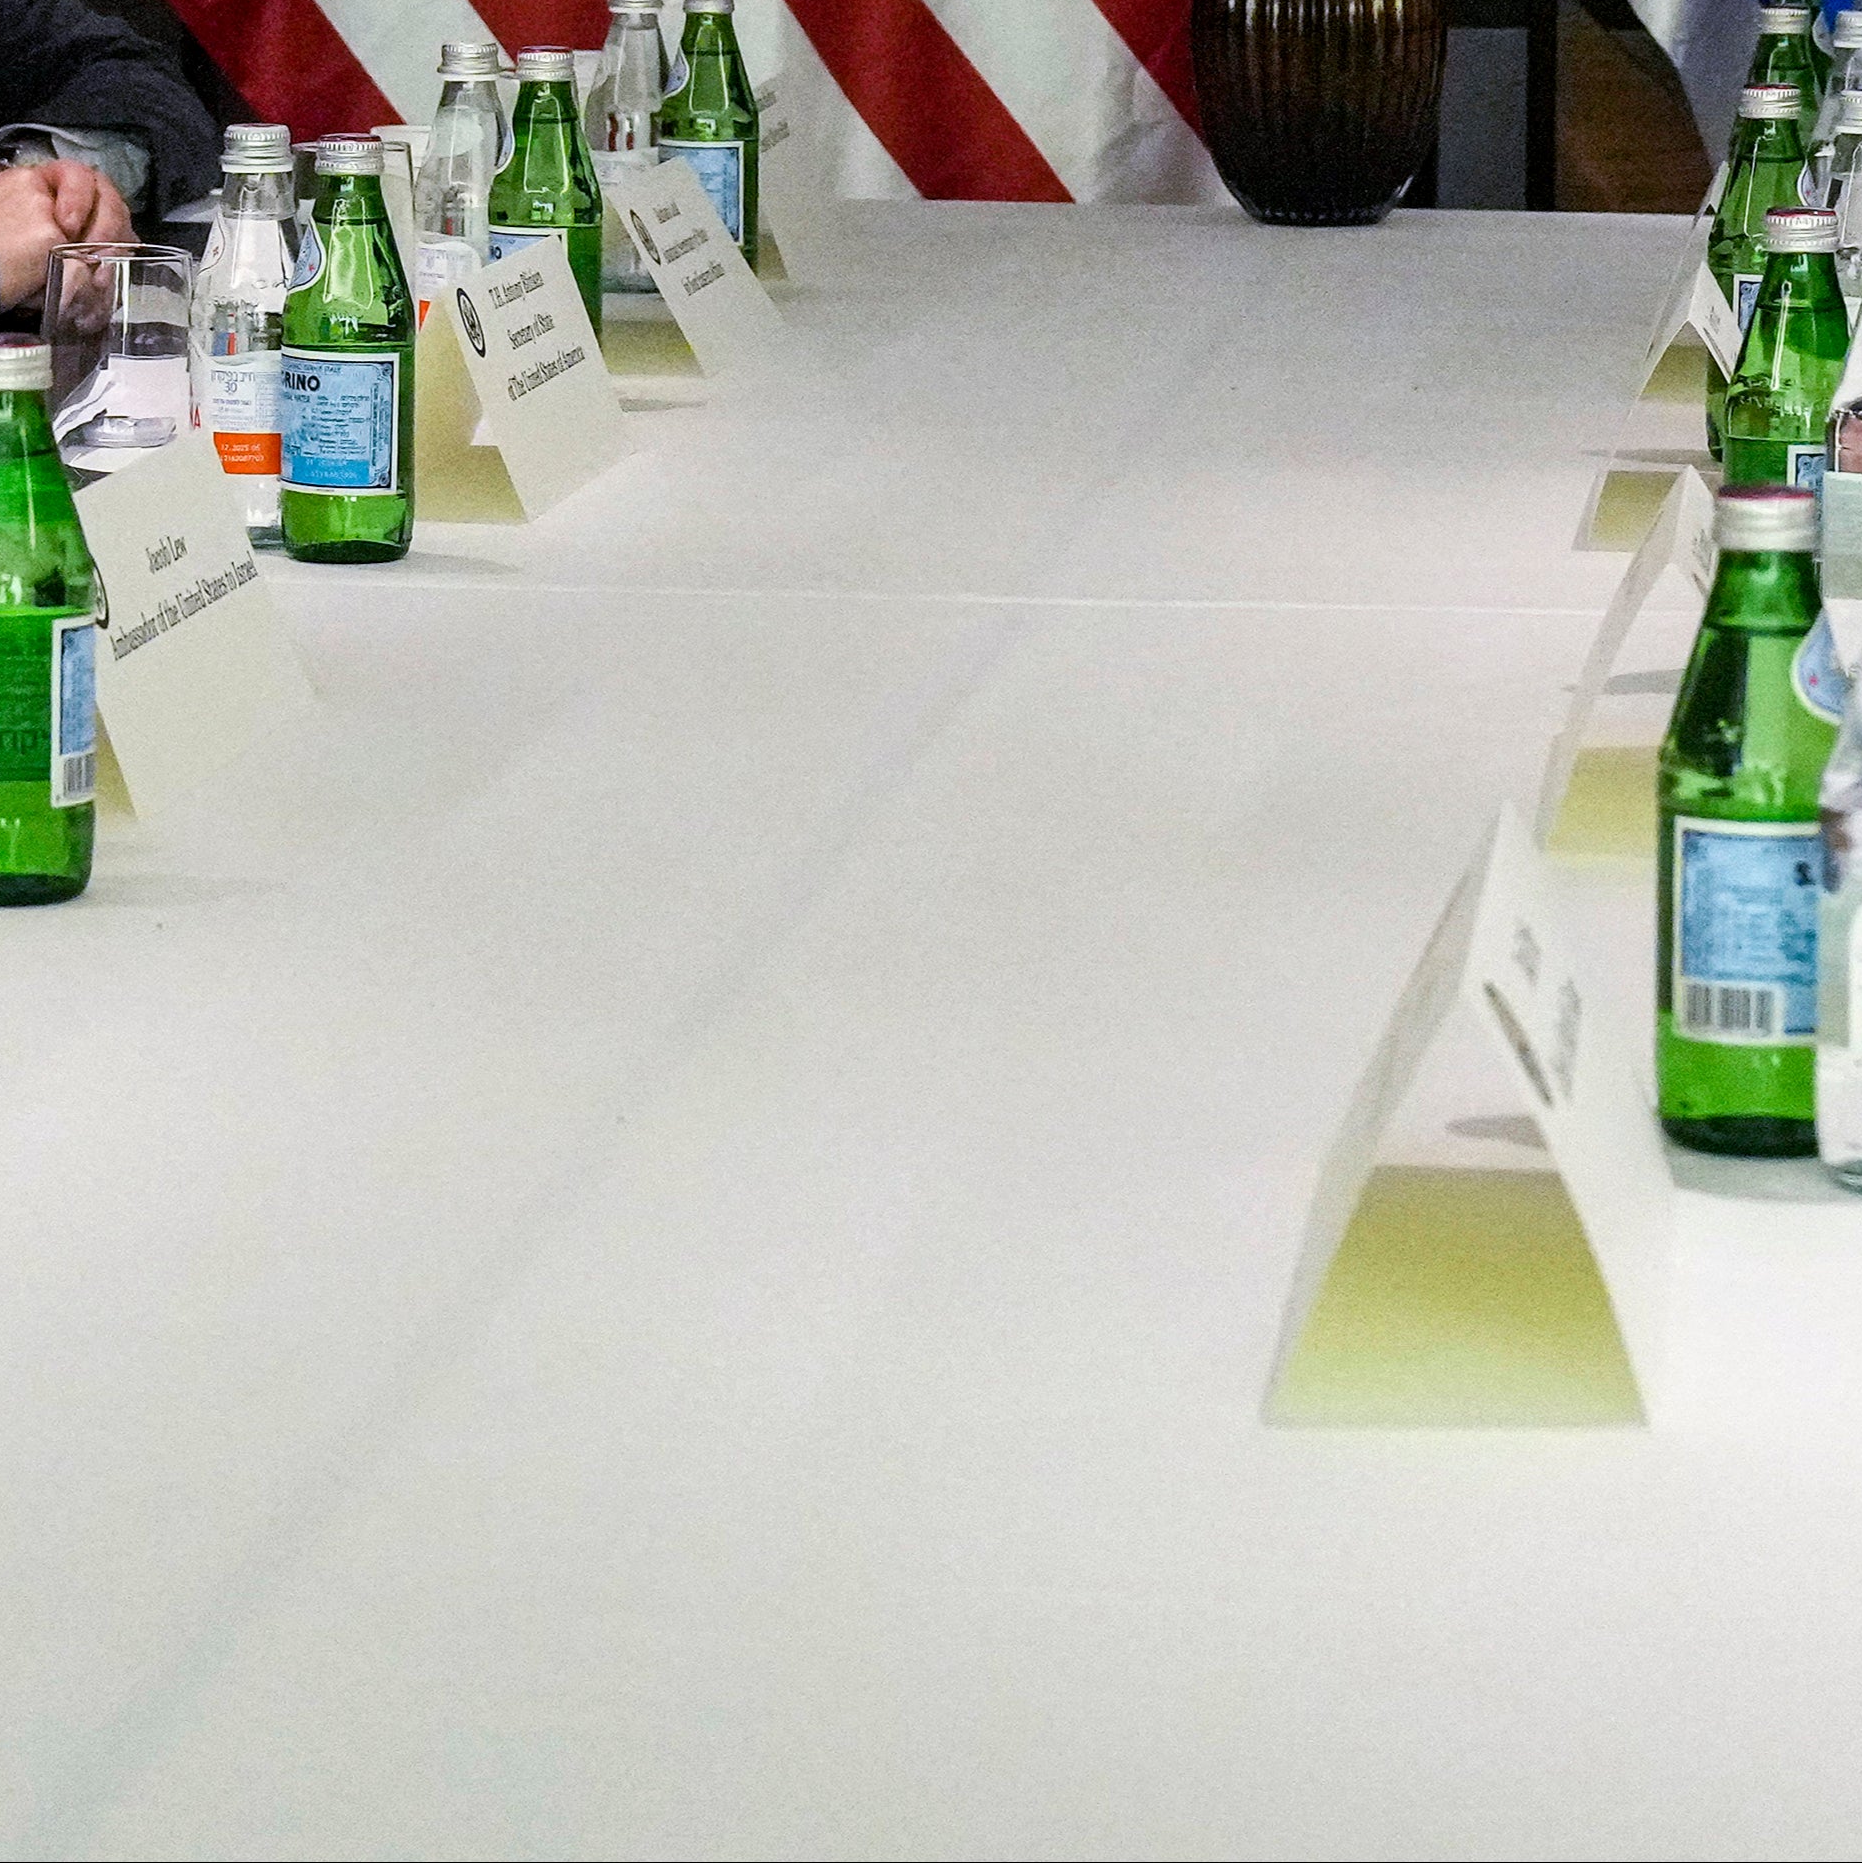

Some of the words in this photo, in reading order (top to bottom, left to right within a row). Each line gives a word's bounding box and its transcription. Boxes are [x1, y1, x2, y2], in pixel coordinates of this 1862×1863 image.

[507, 325, 536, 350] Secretary
[537, 312, 555, 334] State
[521, 363, 544, 392] United
[539, 360, 560, 383] States
[562, 342, 586, 370] America
[145, 538, 172, 575] Jacob
[167, 536, 188, 562] Lew
[110, 612, 159, 661] Ambassador
[164, 599, 181, 627] the
[175, 580, 207, 619] United
[202, 577, 229, 605] States
[224, 569, 238, 591] to
[231, 550, 259, 587] Israel
